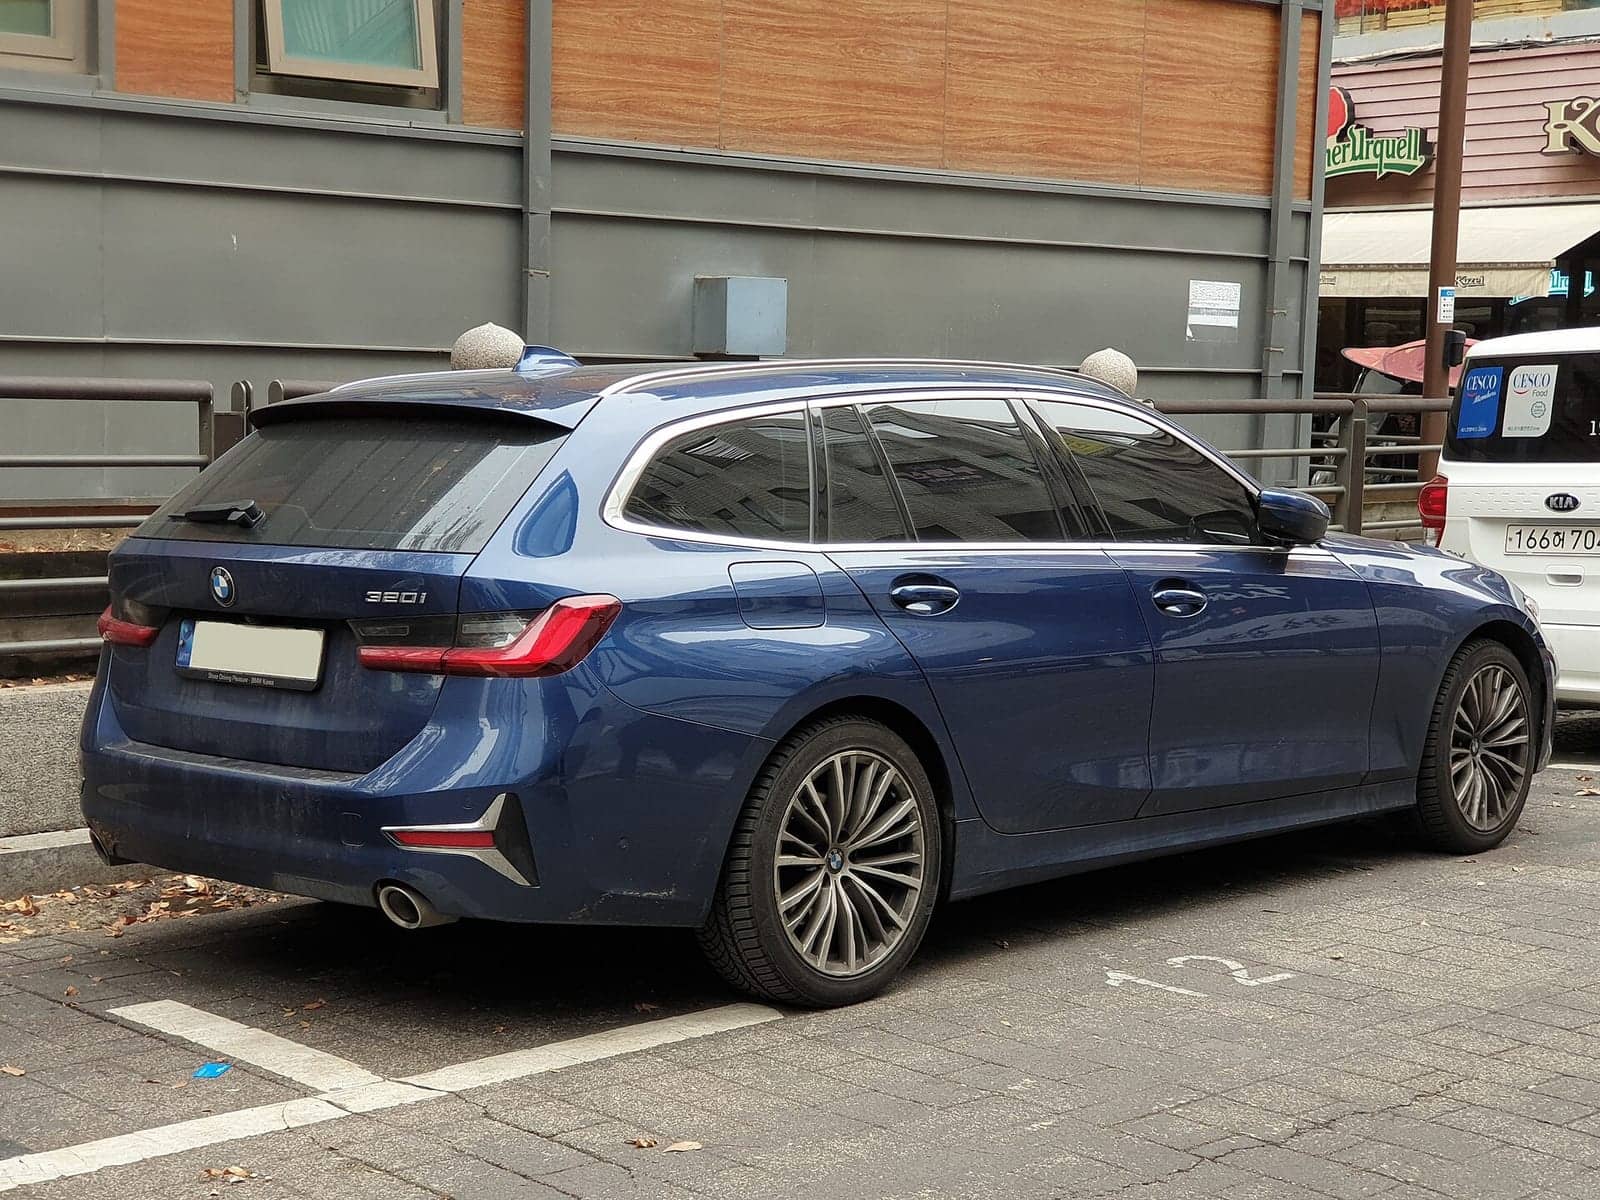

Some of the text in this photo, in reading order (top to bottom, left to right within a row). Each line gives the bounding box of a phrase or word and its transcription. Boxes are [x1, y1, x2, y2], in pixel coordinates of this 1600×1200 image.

[1541, 98, 1600, 153] K
[1348, 125, 1418, 175] Urquell
[1466, 374, 1497, 391] CESCO
[1513, 372, 1551, 389] CESCO
[1532, 389, 1548, 398] Food
[1549, 496, 1575, 509] KIA
[1515, 528, 1566, 550] 166허
[365, 591, 427, 604] 320i
[1104, 954, 1292, 998] 12
